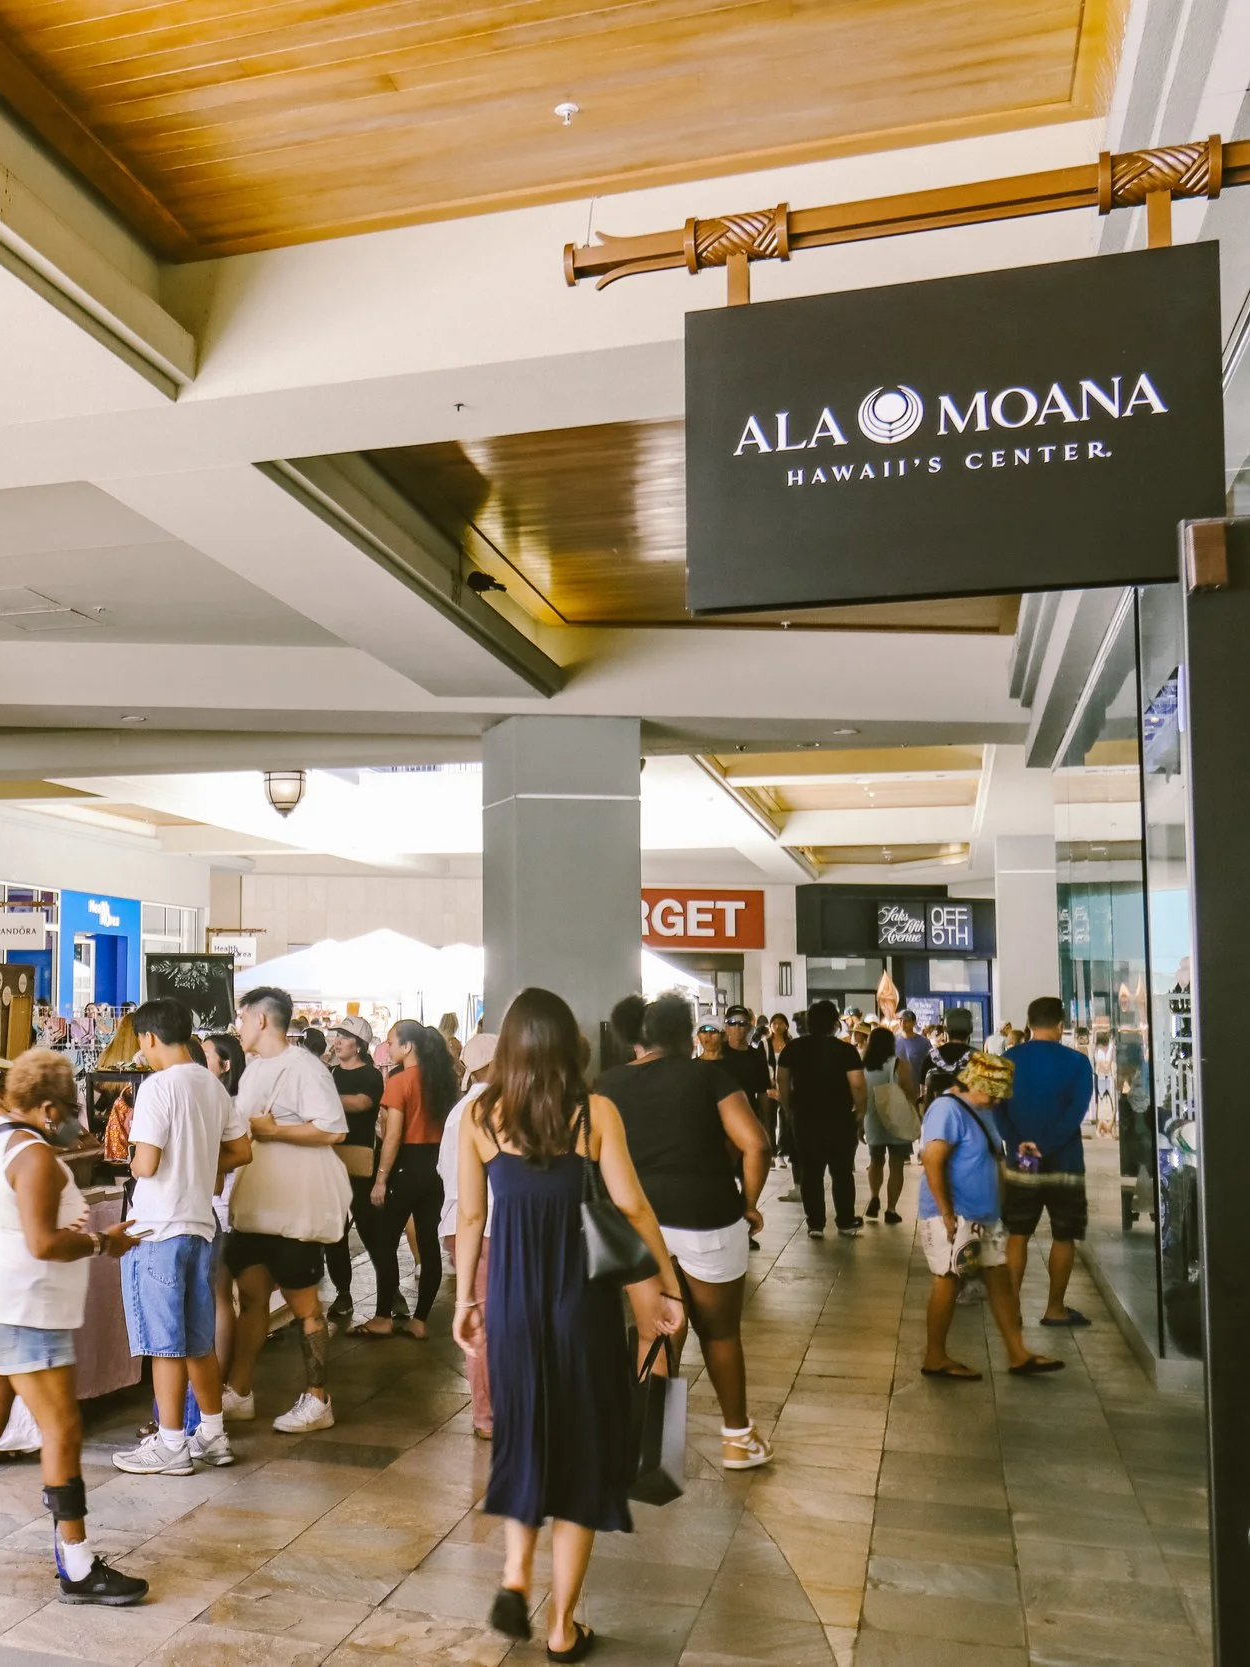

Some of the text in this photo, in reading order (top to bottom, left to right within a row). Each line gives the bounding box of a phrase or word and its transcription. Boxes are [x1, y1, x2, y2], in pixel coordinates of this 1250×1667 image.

[733, 372, 1169, 457] ALA MOANA
[786, 456, 943, 487] HAWAII'S
[878, 906, 909, 927] Saks
[931, 907, 968, 928] OFF
[878, 926, 922, 945] Avenue
[931, 925, 969, 946] 5TH
